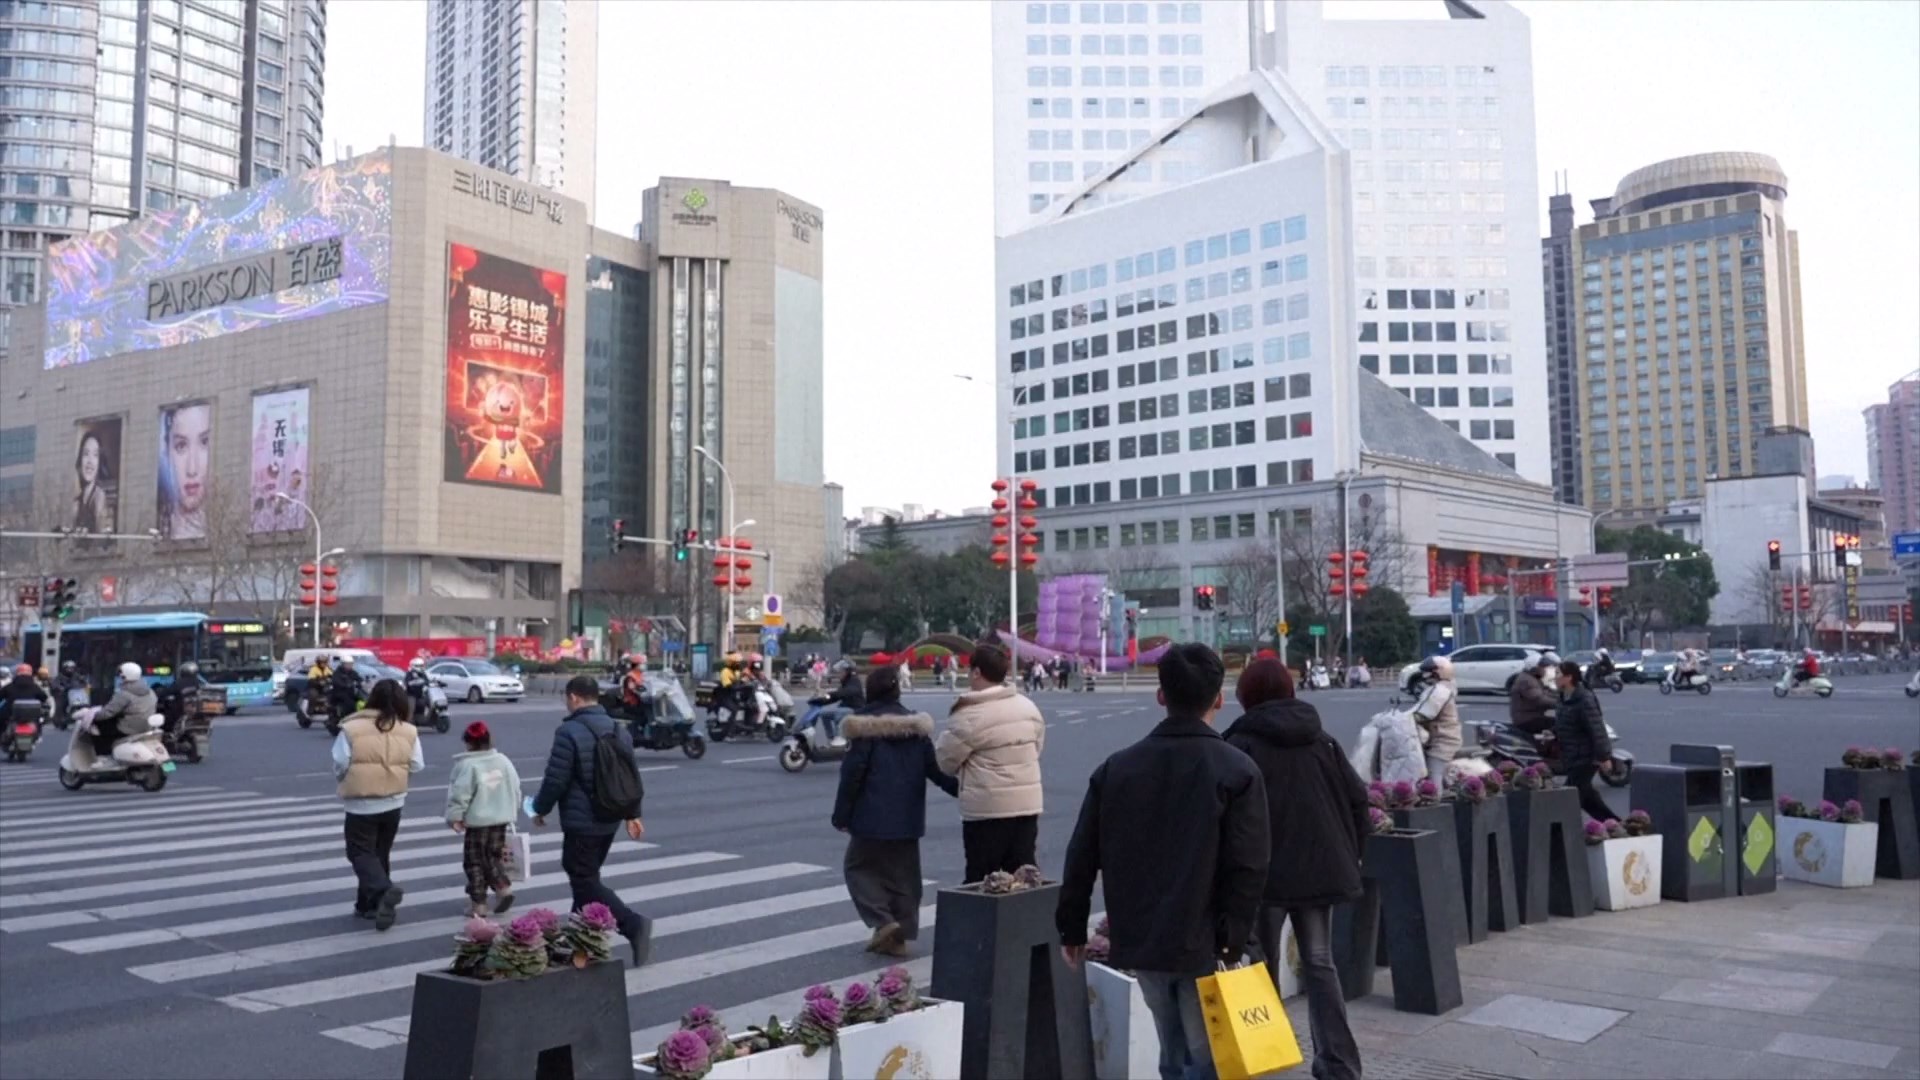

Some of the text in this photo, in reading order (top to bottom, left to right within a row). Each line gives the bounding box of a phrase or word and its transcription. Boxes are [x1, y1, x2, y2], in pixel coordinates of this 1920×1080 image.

[777, 198, 824, 232] PARKSON
[147, 237, 343, 321] PARKSON 百盛
[467, 308, 549, 346] 乐享生活
[1238, 1005, 1270, 1026] KKV
